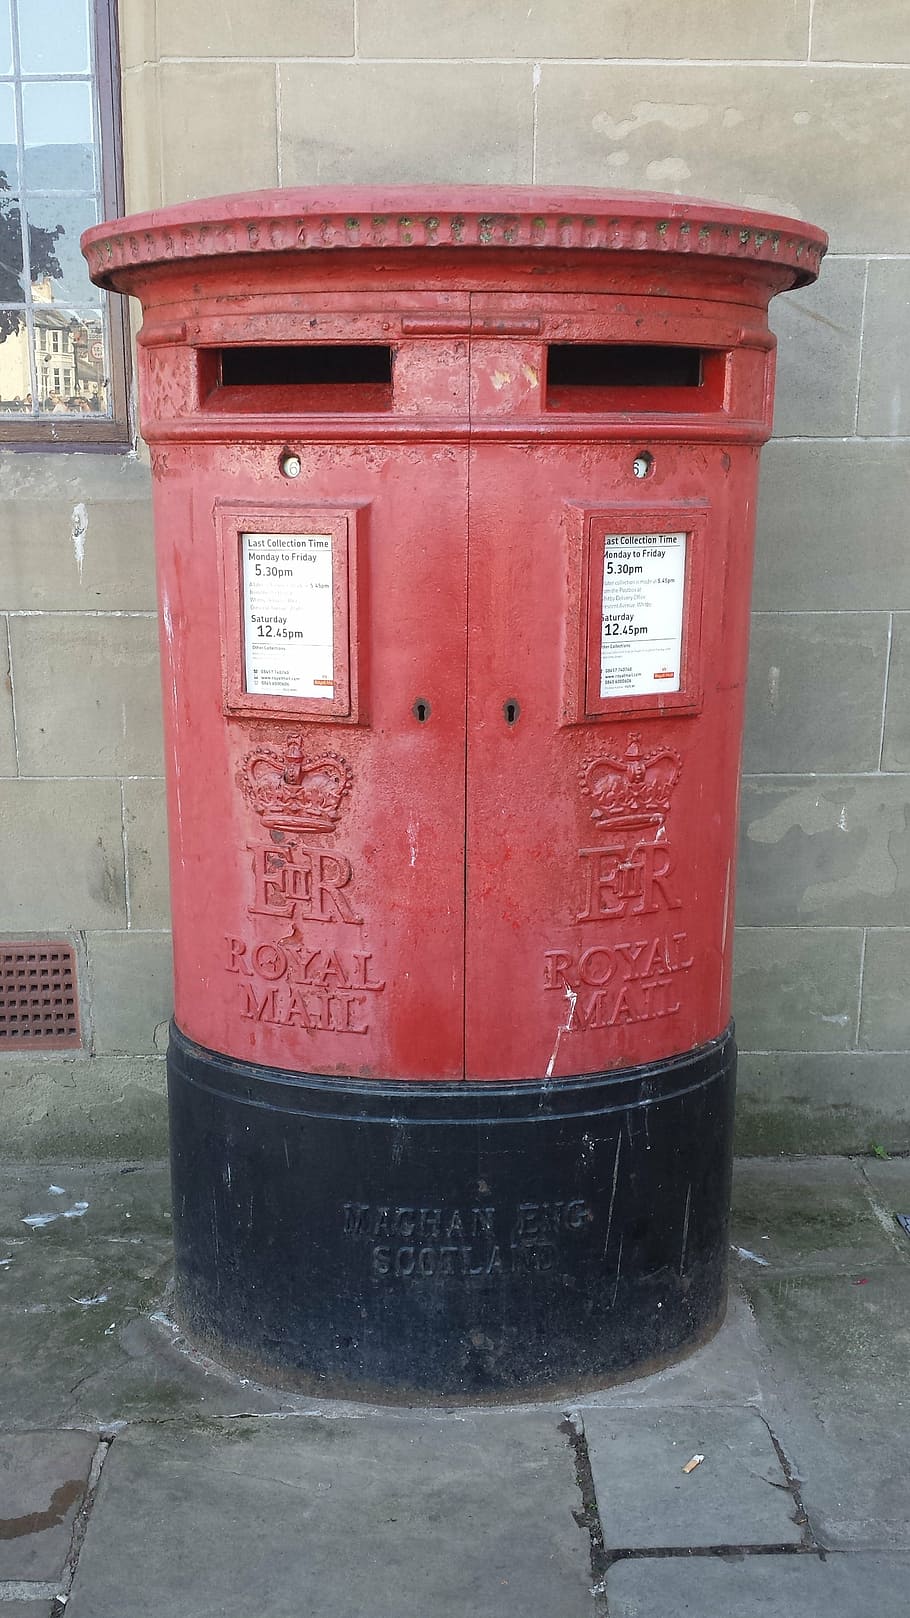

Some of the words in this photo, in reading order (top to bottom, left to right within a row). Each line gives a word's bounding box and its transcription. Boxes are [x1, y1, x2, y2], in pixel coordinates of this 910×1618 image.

[290, 462, 297, 475] 6
[248, 539, 265, 548] Last
[267, 539, 306, 548] Collection
[308, 539, 328, 548] Time
[604, 536, 618, 545] ast
[620, 536, 657, 544] Collection
[659, 535, 678, 544] Time
[248, 552, 279, 562] Monday
[292, 552, 317, 563] Friday
[642, 549, 666, 558] Friday
[255, 564, 293, 578] 5.30pm
[606, 562, 643, 575] 5.30pm
[251, 614, 287, 625] Saturday
[257, 624, 304, 640] 12.45pm
[605, 623, 648, 636] 12.45pm
[224, 936, 386, 992] ROYAL
[544, 932, 694, 990] ROYAL
[237, 984, 369, 1034] MAIL
[569, 979, 681, 1032] MAIL
[373, 1243, 554, 1275] SCOTLAND
